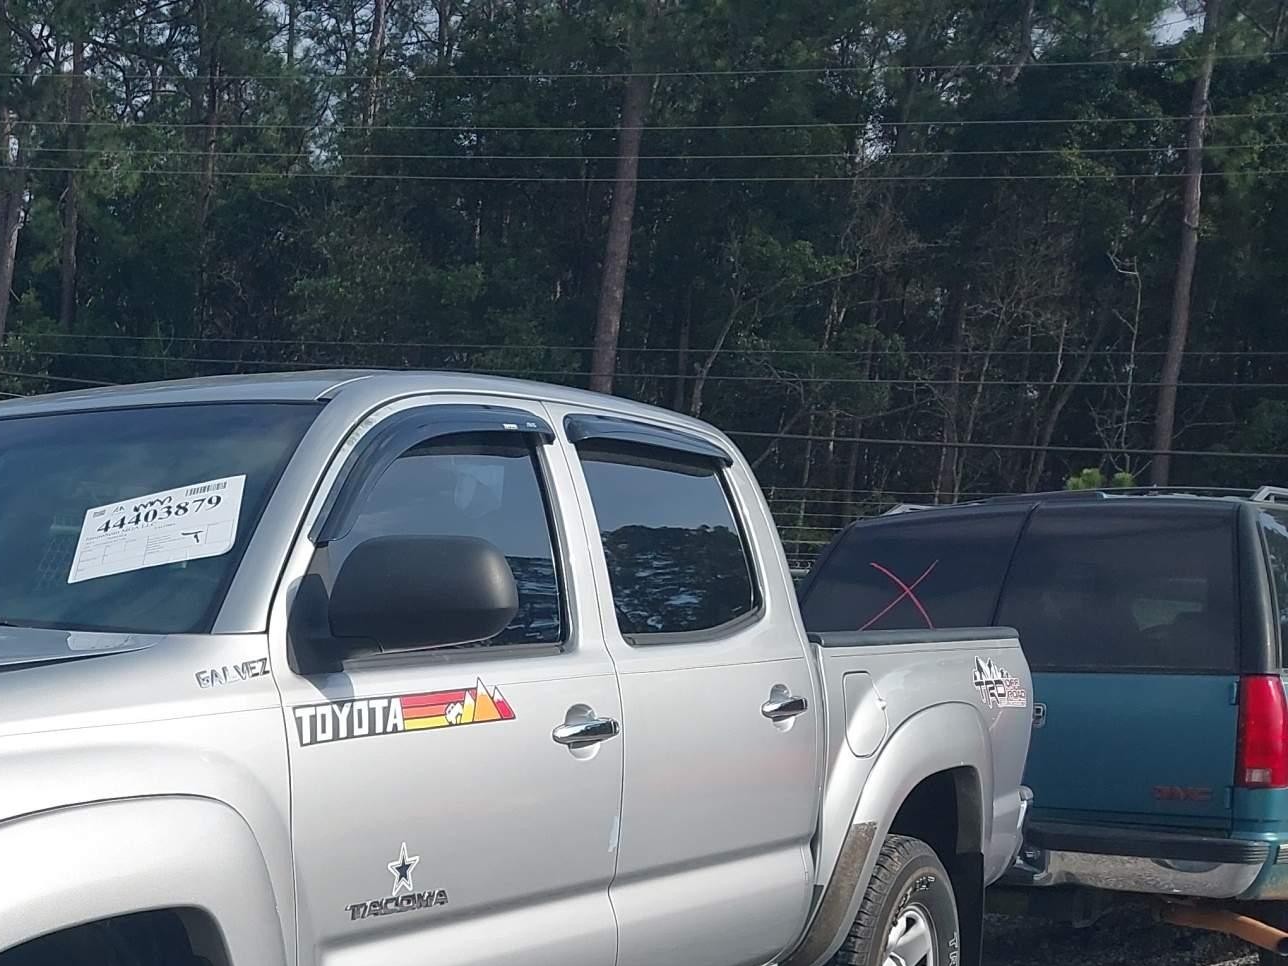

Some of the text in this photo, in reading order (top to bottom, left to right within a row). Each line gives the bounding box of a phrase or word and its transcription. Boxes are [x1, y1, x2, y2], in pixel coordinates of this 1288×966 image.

[97, 495, 222, 533] 44403879
[195, 657, 270, 688] GALVEZ
[974, 680, 1007, 705] TRD
[295, 698, 405, 745] TOYOTA
[345, 890, 449, 921] TACOMA
